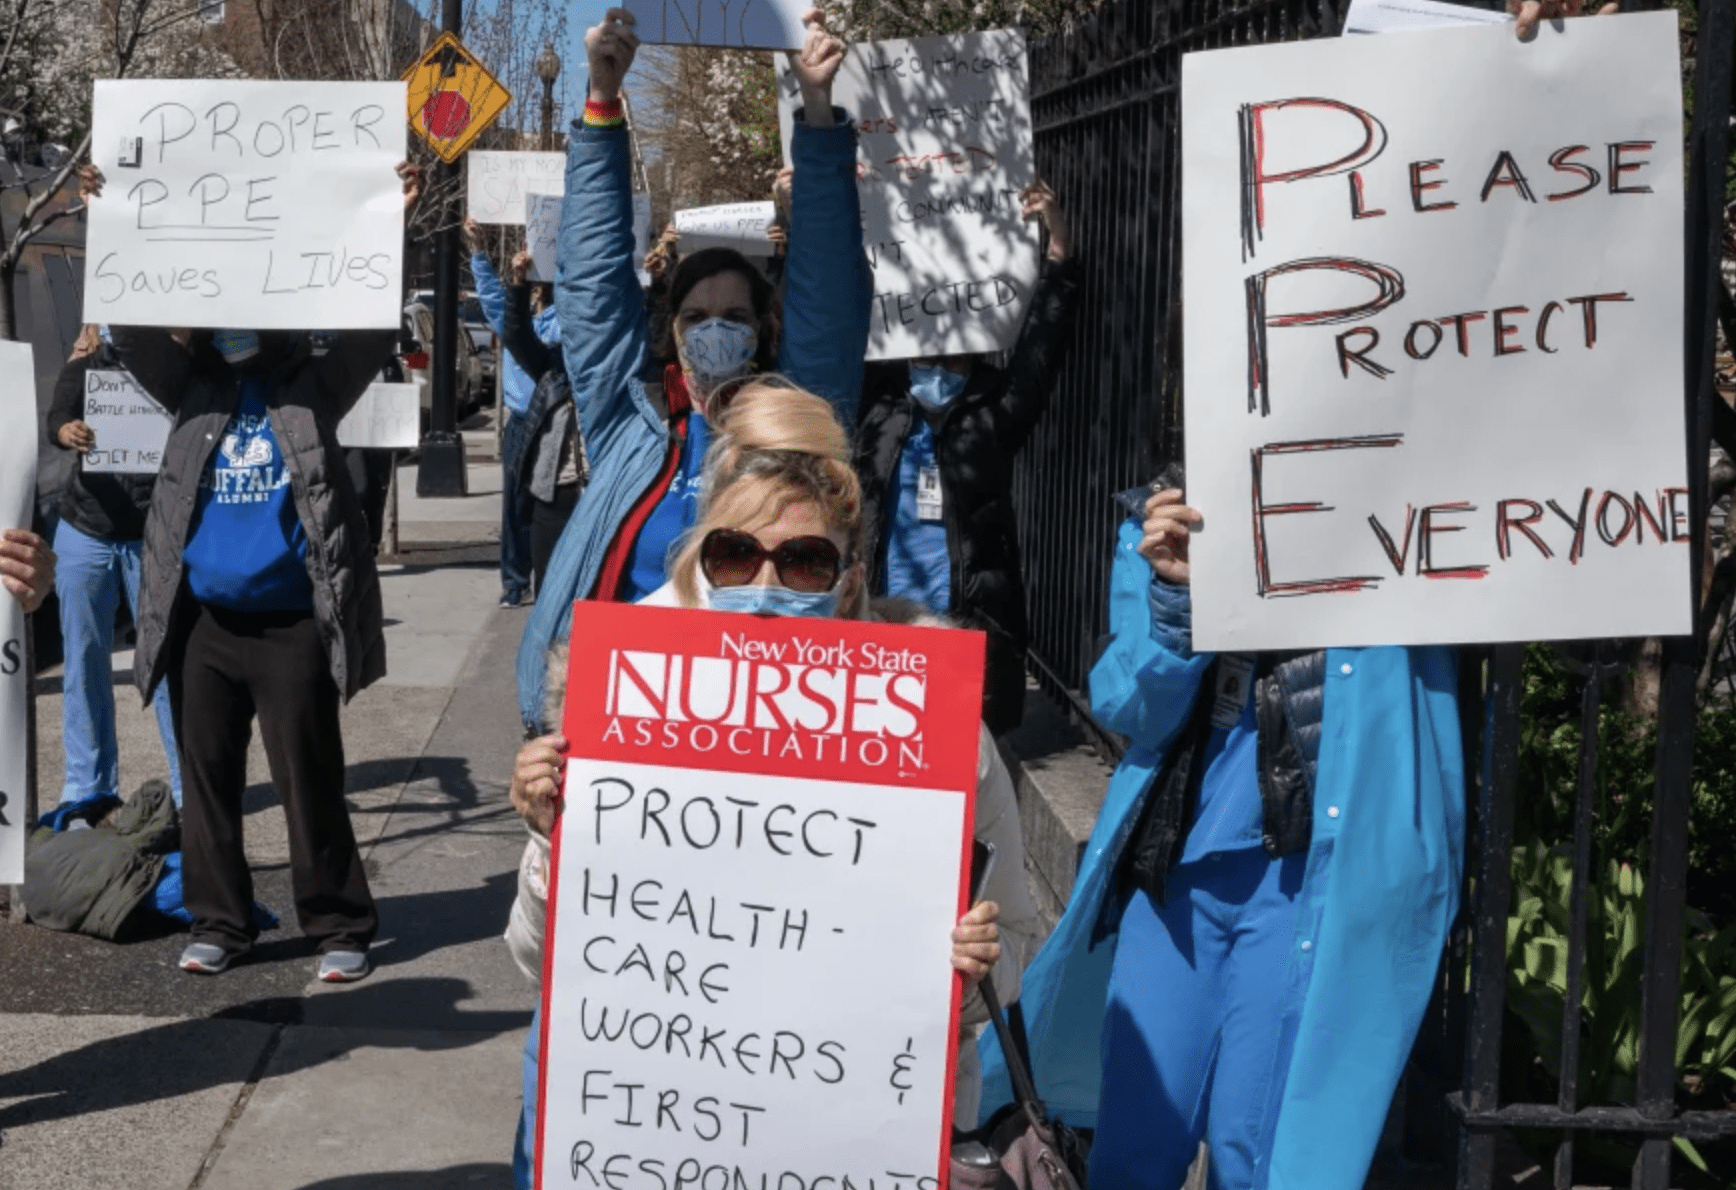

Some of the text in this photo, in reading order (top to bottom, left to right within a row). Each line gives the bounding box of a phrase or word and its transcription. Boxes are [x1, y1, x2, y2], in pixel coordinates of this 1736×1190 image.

[140, 102, 384, 163] PROPER
[128, 173, 280, 230] PPE
[1239, 97, 1656, 263] PLEASE
[875, 275, 1016, 333] TECTED
[1245, 256, 1634, 416] PROTECT
[1251, 434, 1692, 598] EVERYONE
[720, 631, 927, 674] New York State
[605, 649, 927, 742] NURSES
[602, 717, 925, 769] ASSOCIATION
[590, 778, 877, 865] PROTECT
[582, 936, 729, 1003] CARE
[582, 997, 845, 1084] WORKERS
[581, 1070, 766, 1146] FIRST
